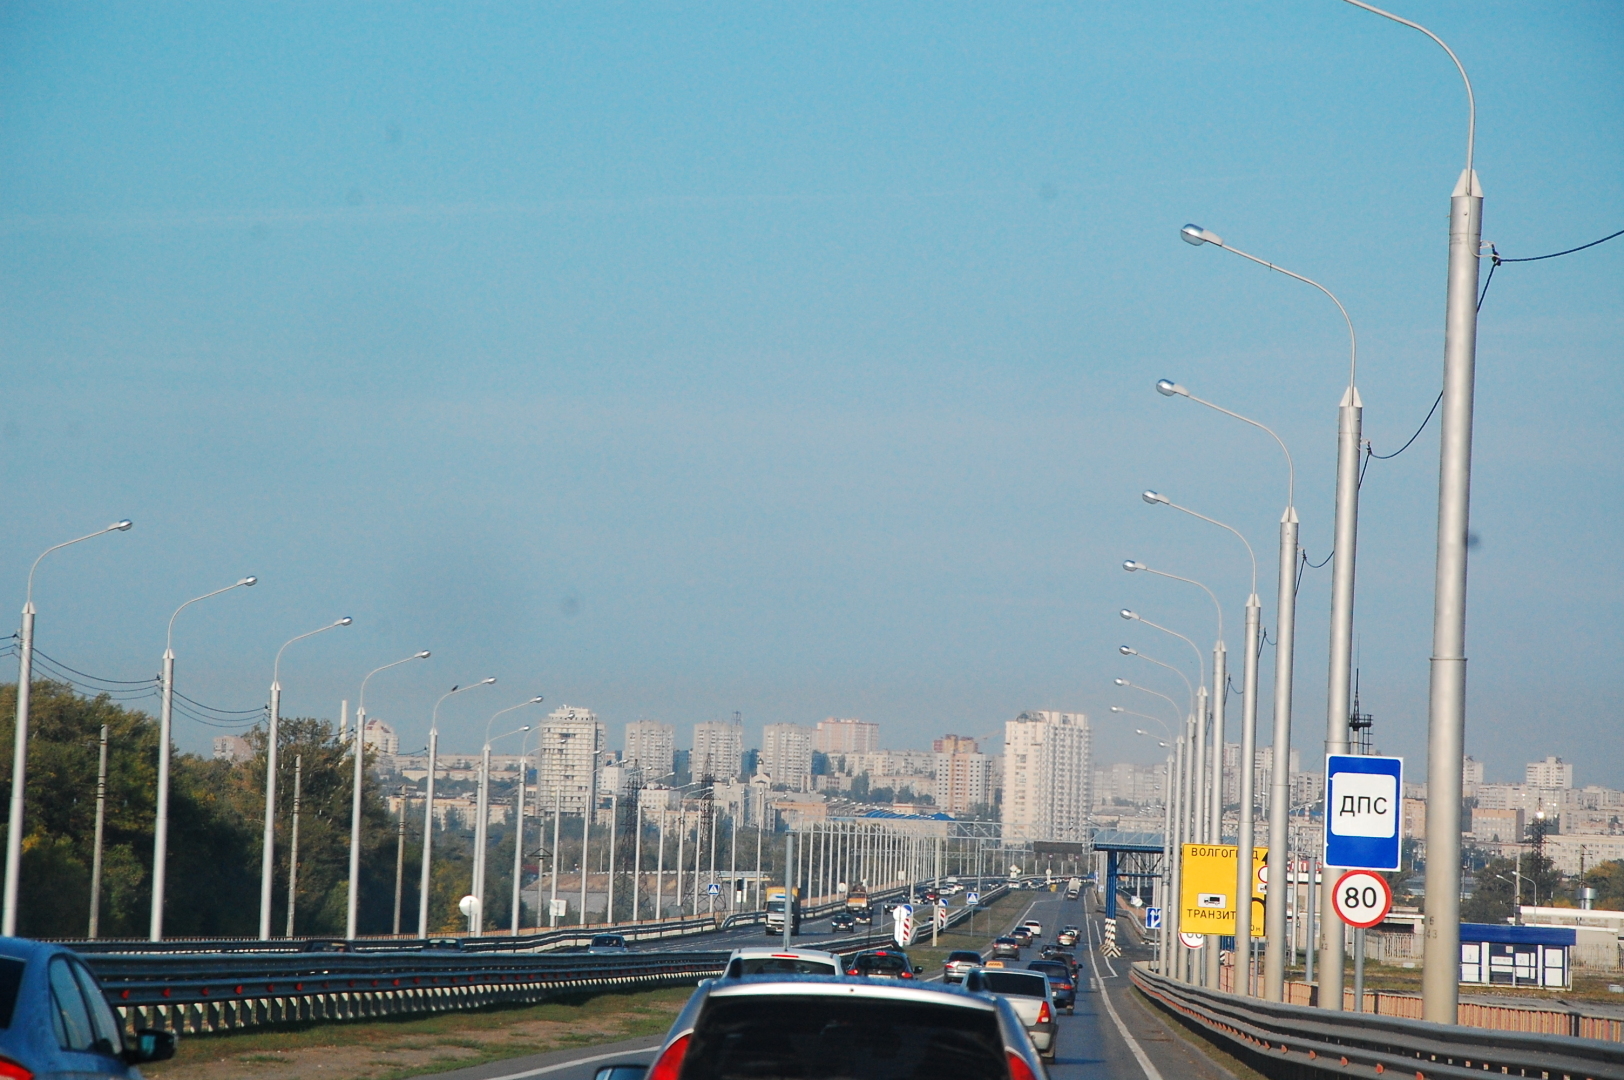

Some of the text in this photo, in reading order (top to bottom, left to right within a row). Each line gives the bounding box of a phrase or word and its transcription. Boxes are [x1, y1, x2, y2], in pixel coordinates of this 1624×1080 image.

[1339, 795, 1388, 817] ДПС
[1191, 847, 1259, 860] ВОЛГОГД
[1344, 886, 1377, 909] 80
[1187, 908, 1237, 920] ТРАНЗИТ
